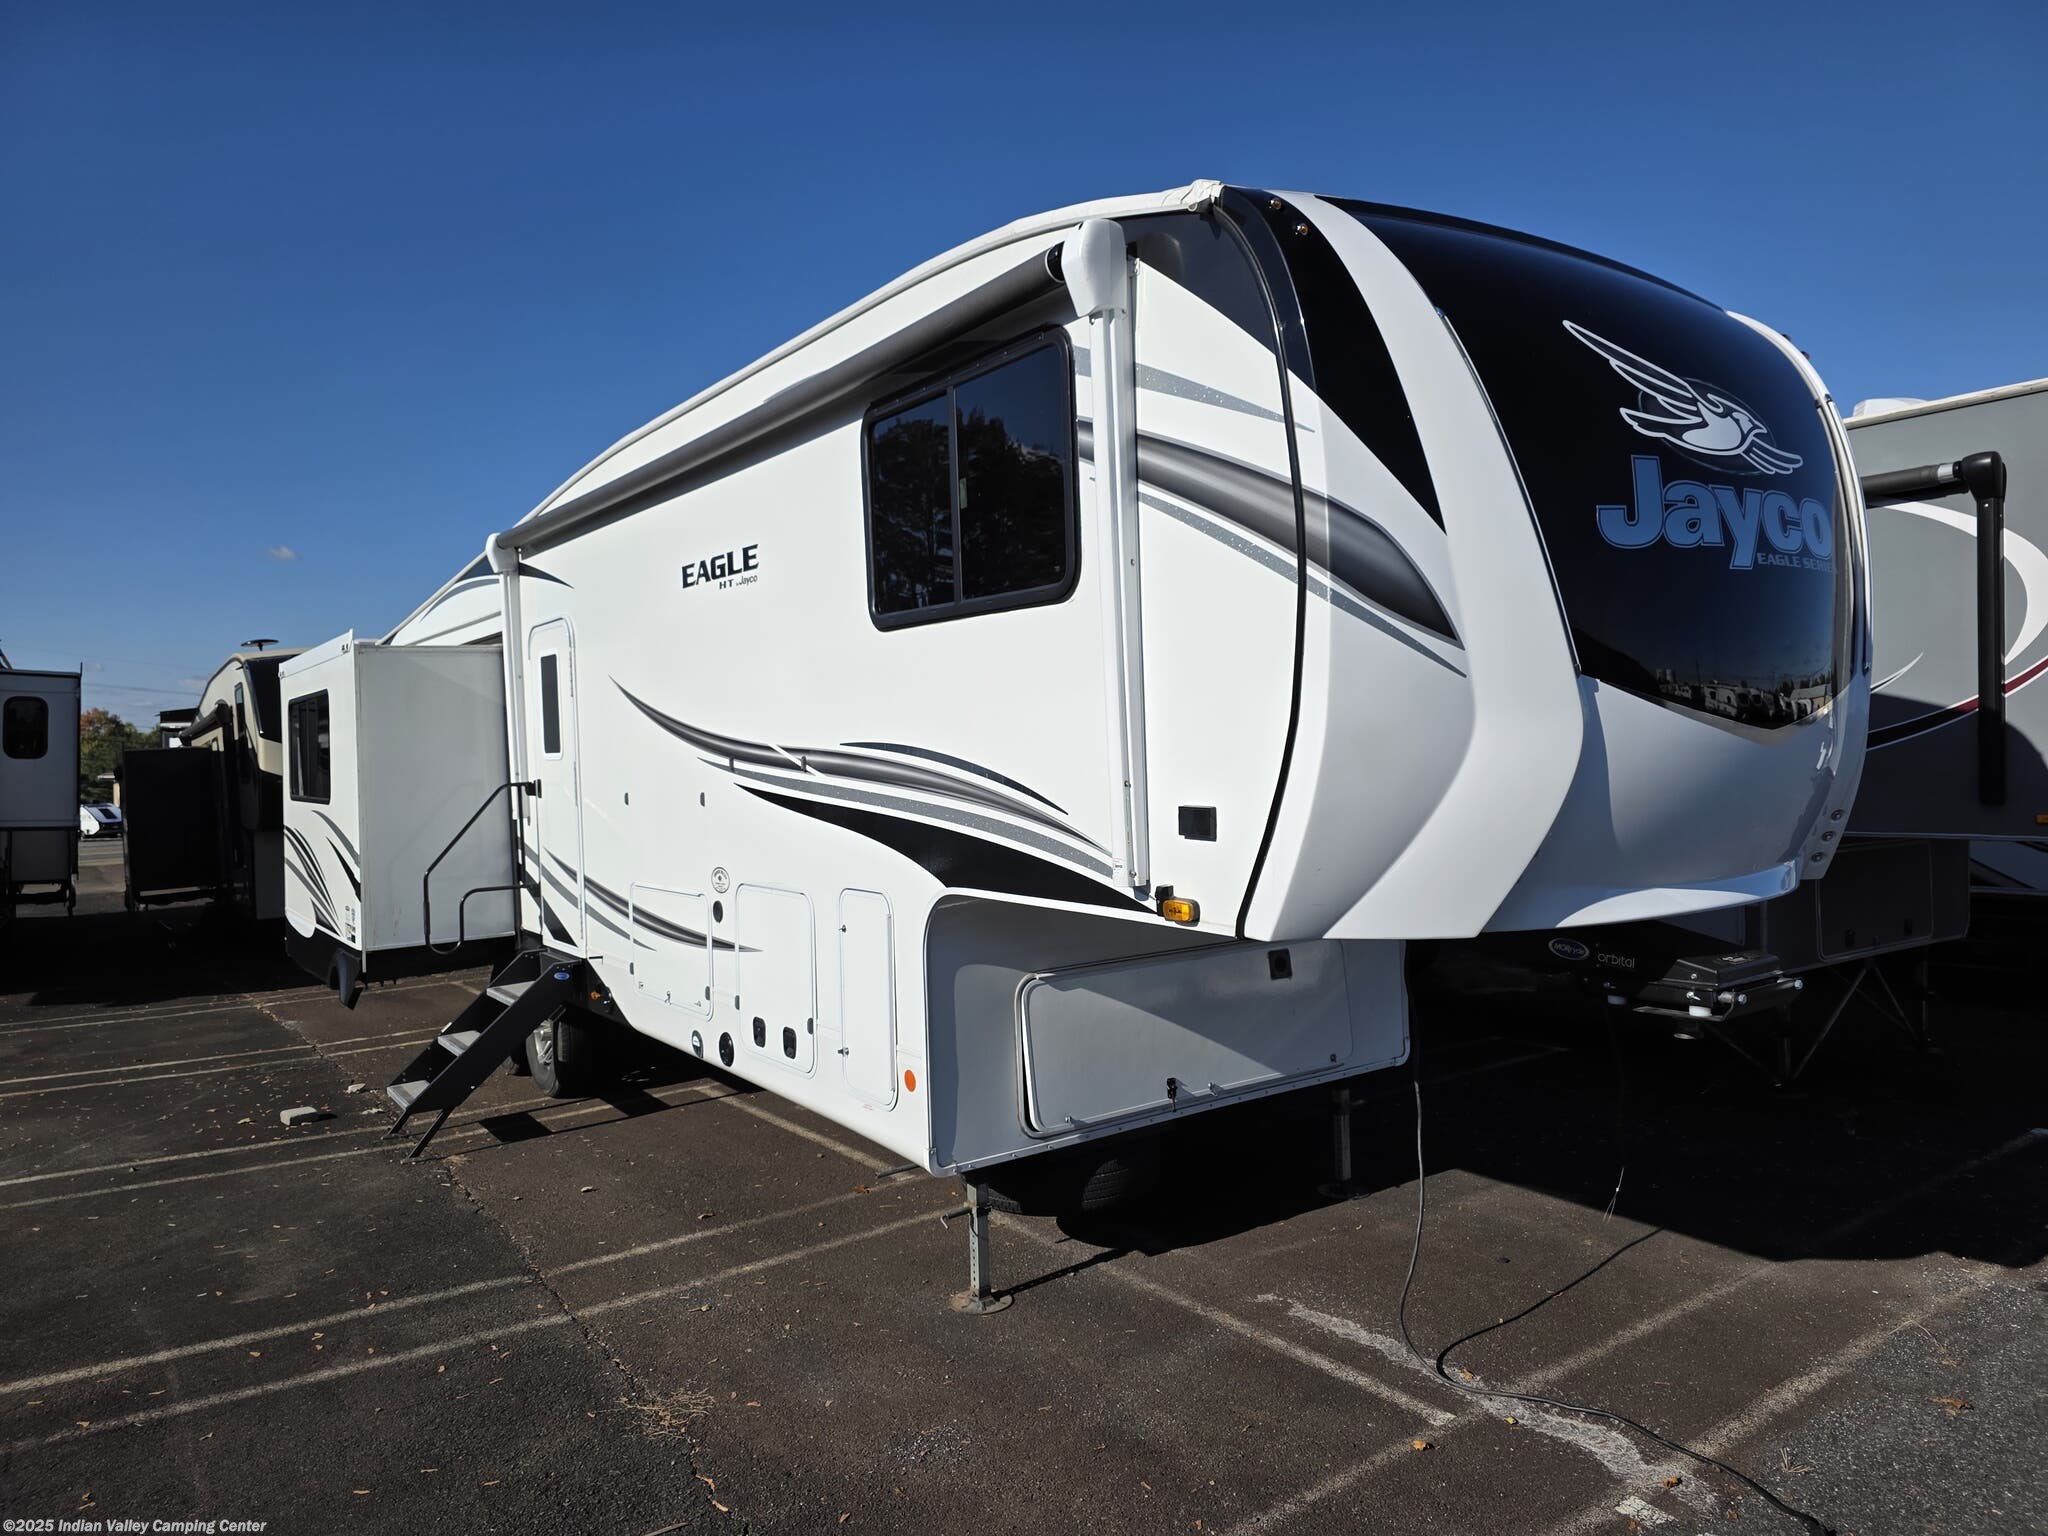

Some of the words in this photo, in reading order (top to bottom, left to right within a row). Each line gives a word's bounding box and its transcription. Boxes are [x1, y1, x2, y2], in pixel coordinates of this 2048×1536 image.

[1596, 454, 1833, 570] Jayco
[682, 544, 759, 588] EAGLE
[1757, 552, 1801, 568] EAGLE
[1801, 556, 1837, 574] SERIE
[1597, 952, 1635, 969] orbital
